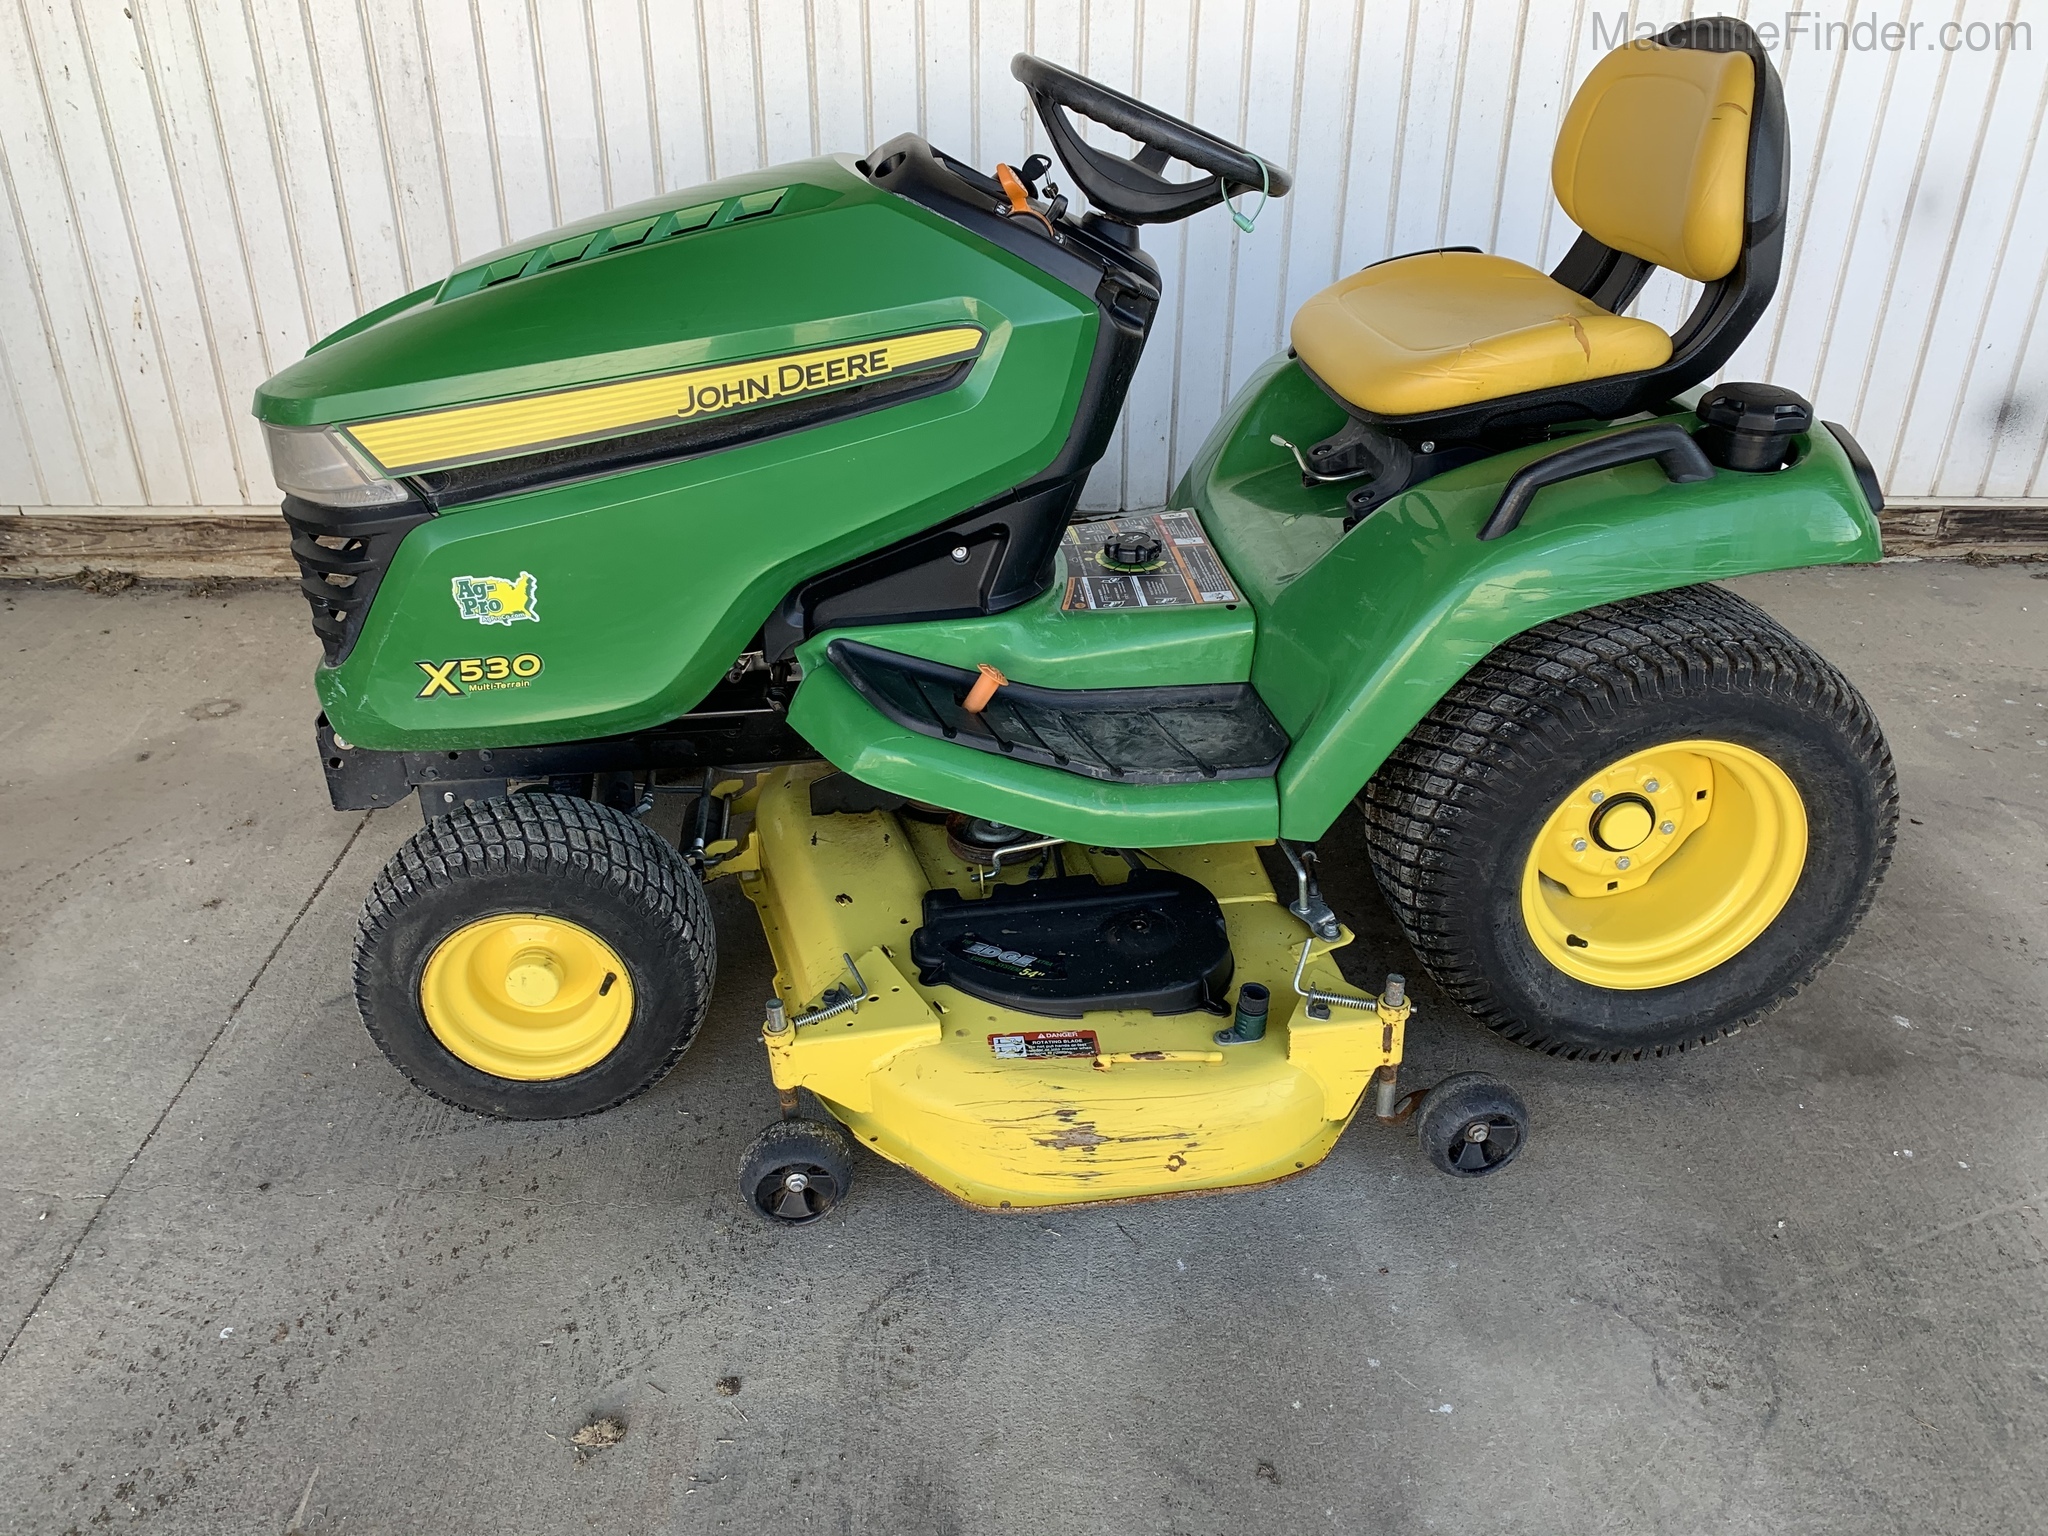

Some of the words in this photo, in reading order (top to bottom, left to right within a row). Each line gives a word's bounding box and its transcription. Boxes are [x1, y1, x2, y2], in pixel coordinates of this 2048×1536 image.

[677, 374, 769, 415] JOHN
[778, 348, 889, 392] DEERE
[457, 580, 496, 599] Ag-
[461, 599, 502, 616] Pro
[415, 653, 543, 698] X530
[468, 680, 530, 692] Multi-Terrain
[962, 941, 1038, 968] EDGE
